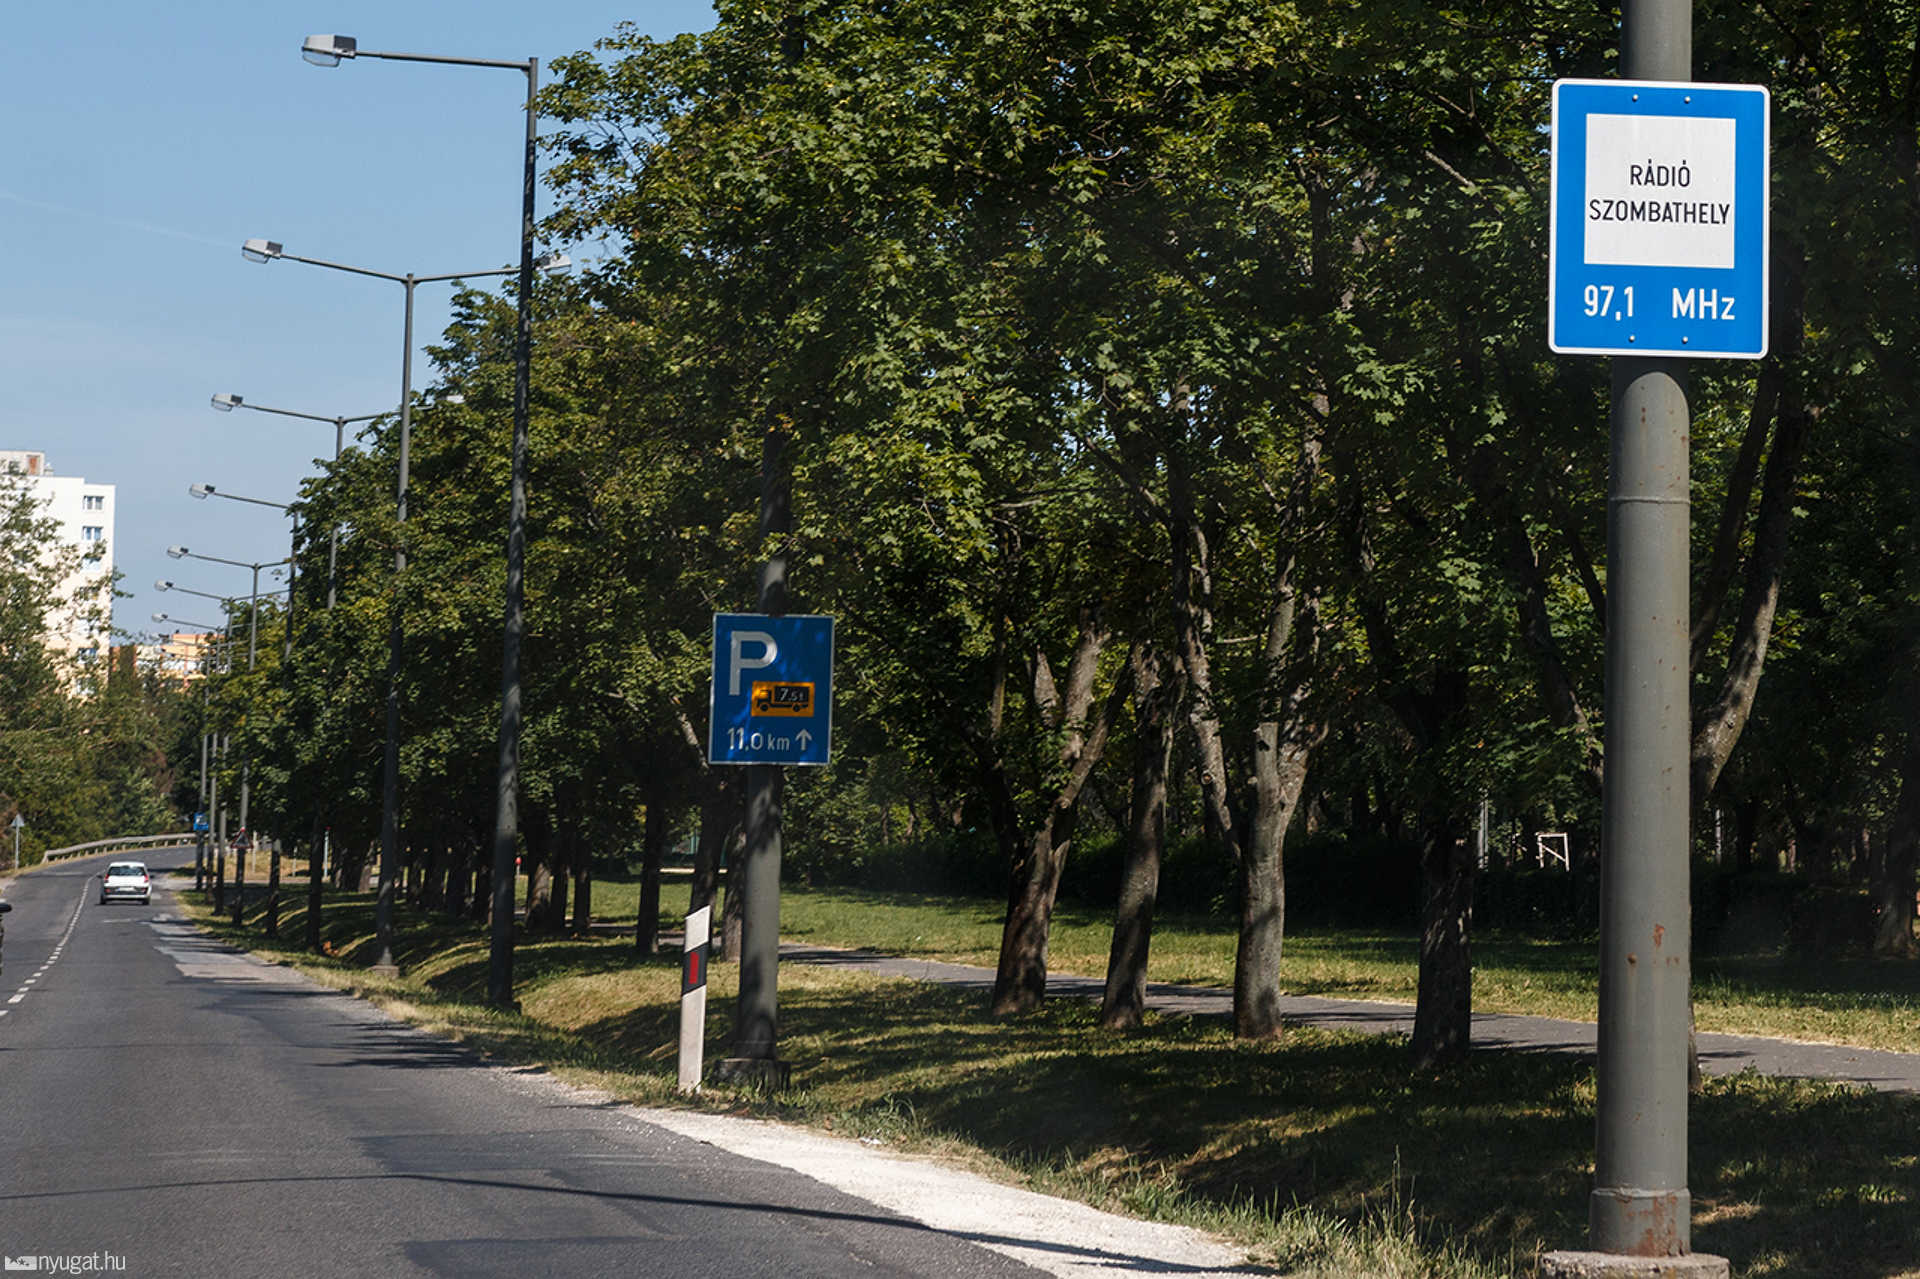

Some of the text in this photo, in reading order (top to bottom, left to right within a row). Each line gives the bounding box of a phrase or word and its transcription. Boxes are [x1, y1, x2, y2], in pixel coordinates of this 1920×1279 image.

[1630, 158, 1690, 187] RÁDIÓ
[1589, 199, 1730, 225] SZOMBATHELY
[1584, 285, 1735, 321] 97,1 MHz
[729, 631, 778, 696] P
[767, 733, 790, 751] km
